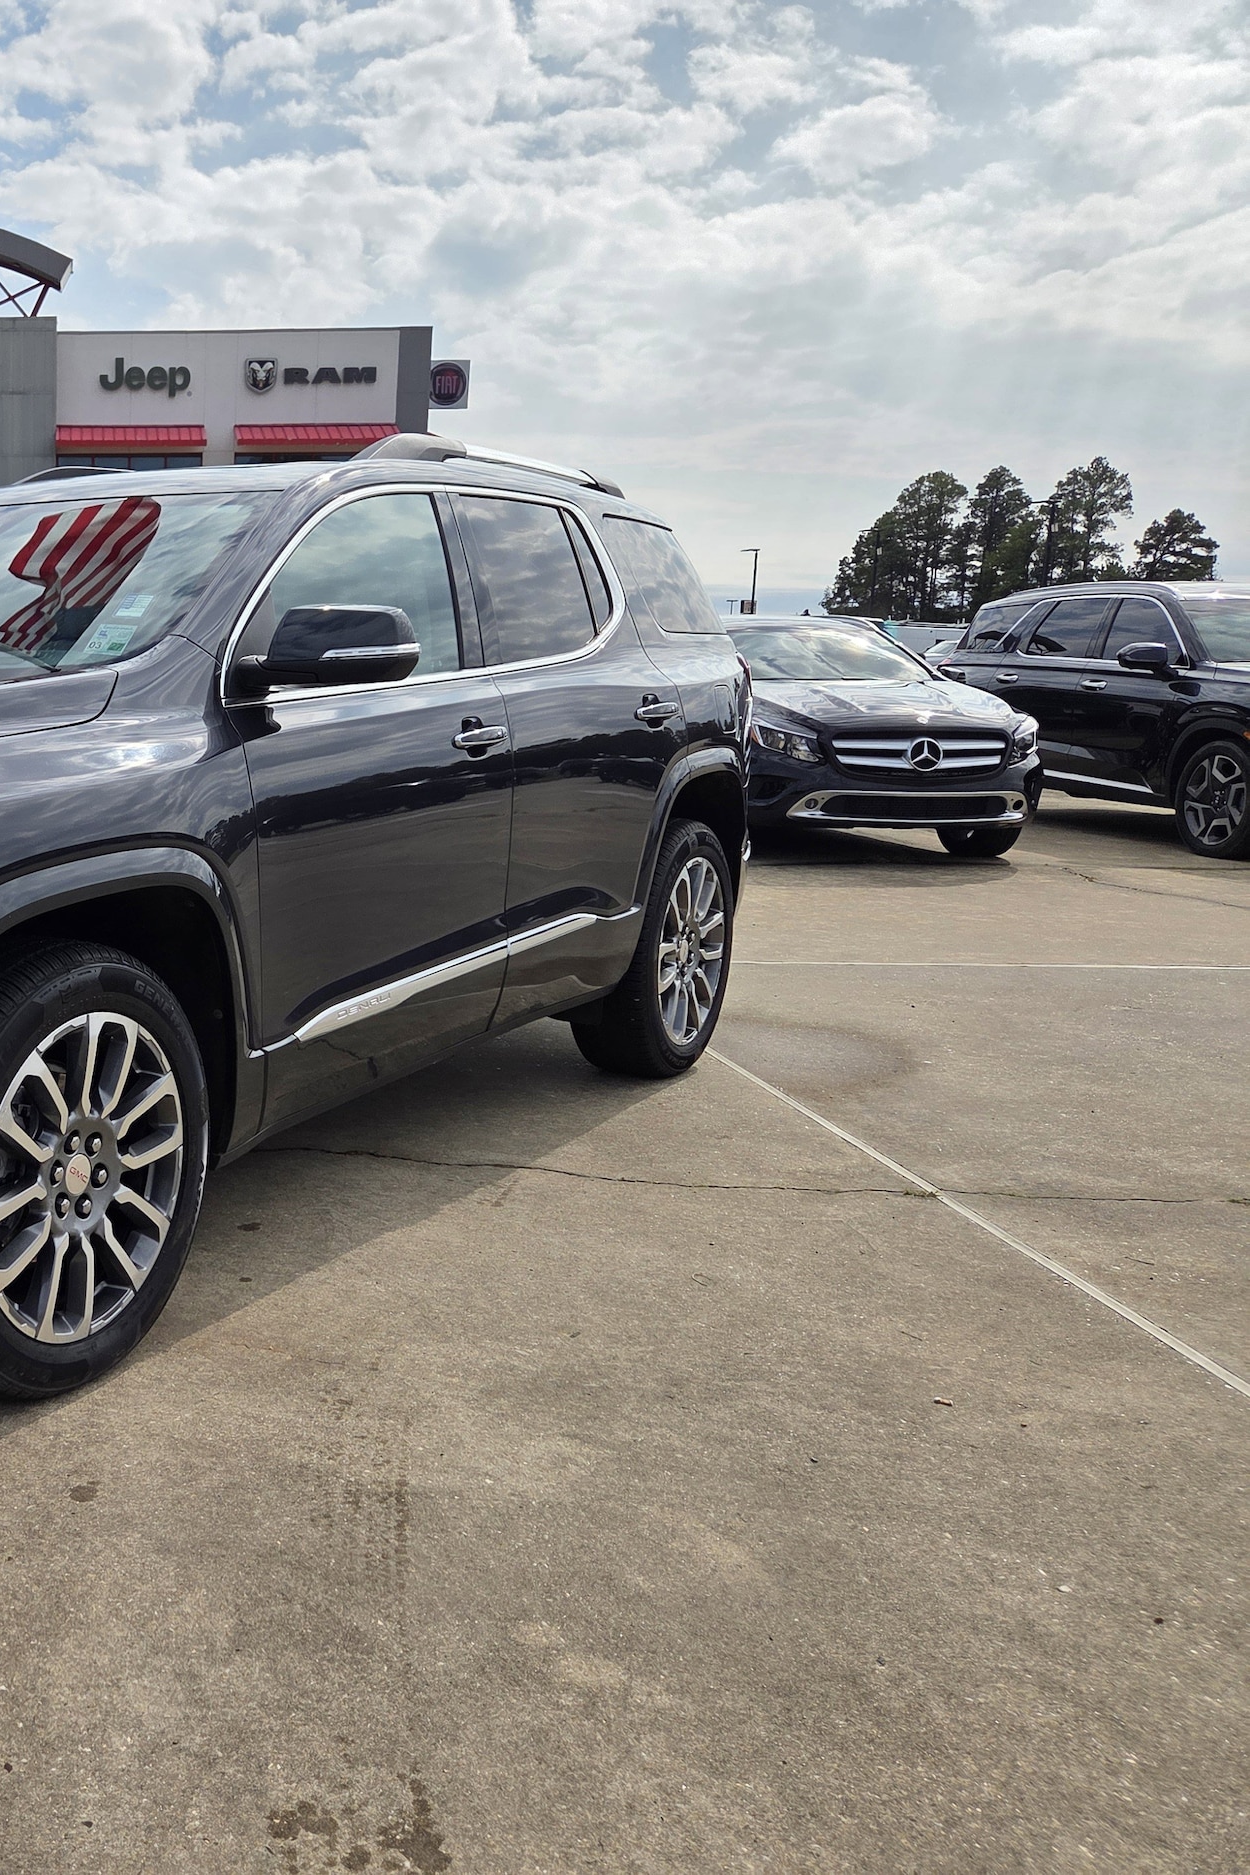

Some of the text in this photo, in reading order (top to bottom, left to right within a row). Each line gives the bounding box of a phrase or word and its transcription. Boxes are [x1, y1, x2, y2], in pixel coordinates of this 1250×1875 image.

[100, 357, 191, 398] Jeep
[283, 366, 378, 385] RAM
[435, 375, 459, 395] FIAT
[88, 641, 102, 650] 03
[337, 993, 391, 1020] DENALI
[69, 1166, 89, 1184] GMC
